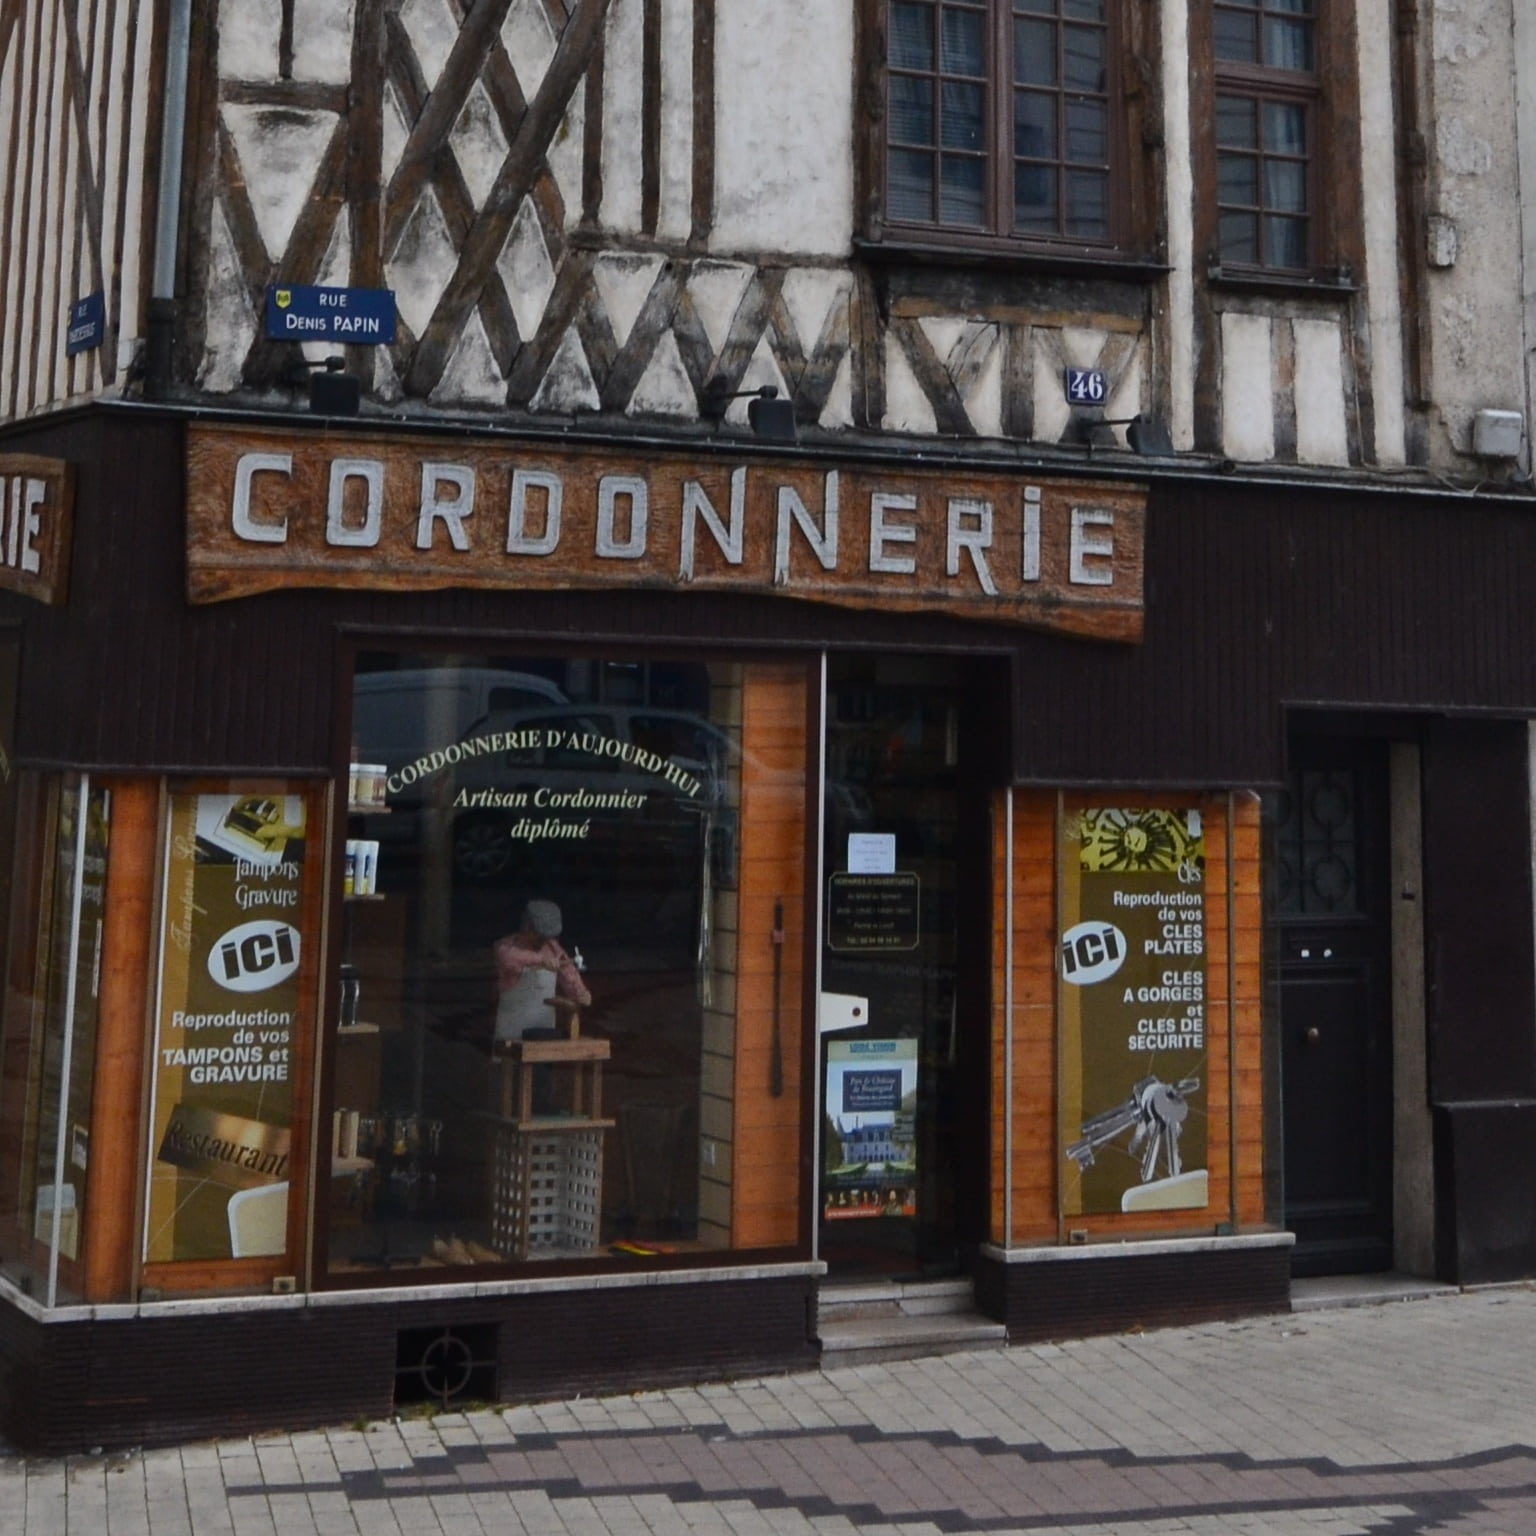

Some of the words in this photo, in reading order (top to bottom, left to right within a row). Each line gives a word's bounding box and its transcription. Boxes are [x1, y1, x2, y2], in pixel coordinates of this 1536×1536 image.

[319, 293, 348, 307] RUE
[333, 315, 380, 333] PAPIN
[1071, 371, 1103, 400] 46
[386, 729, 542, 794] CORDONNERIE
[547, 730, 701, 798] D'AUJOURD'HUI
[453, 787, 528, 809] Artisan
[534, 786, 648, 810] Cordonnier
[511, 818, 591, 843] diplômé
[232, 856, 299, 882] Tampons
[235, 883, 298, 910] Gravure
[1114, 890, 1202, 908] Reproduction
[1158, 907, 1176, 921] de
[1179, 909, 1202, 921] vos
[1163, 924, 1202, 938] CLES
[1145, 940, 1202, 955] PLATES
[1162, 971, 1203, 986] CLES
[1123, 988, 1134, 1003] A
[1137, 987, 1203, 1003] GORGES
[172, 1009, 290, 1030] Reproduction
[1186, 1004, 1203, 1017] et
[1138, 1019, 1176, 1034] CLES
[1181, 1018, 1202, 1033] DE
[233, 1028, 254, 1045] de
[259, 1030, 290, 1044] vos
[1128, 1034, 1203, 1050] SECURITE
[162, 1046, 263, 1066] TAMPONS
[269, 1048, 289, 1063] et
[190, 1064, 289, 1084] GRAVURE
[170, 1119, 289, 1177] Restaurant
